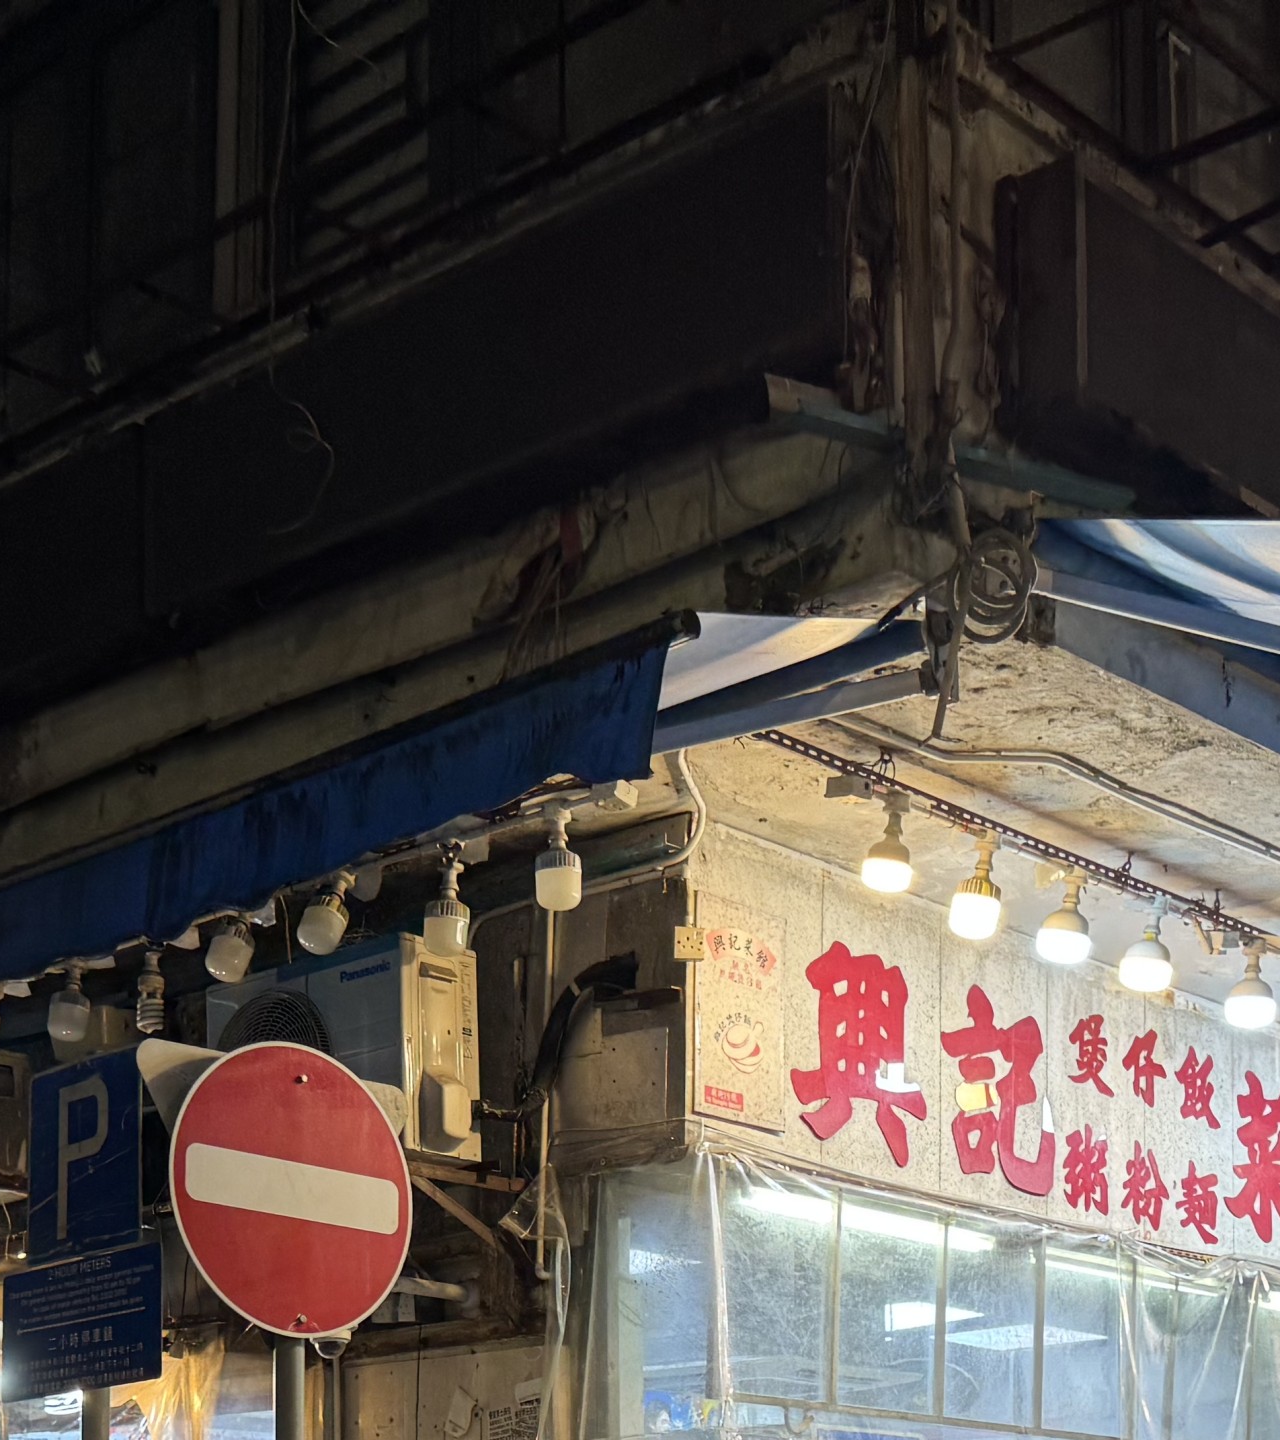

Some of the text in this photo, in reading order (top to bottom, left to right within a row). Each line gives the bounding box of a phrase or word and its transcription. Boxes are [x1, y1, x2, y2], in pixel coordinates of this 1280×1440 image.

[339, 959, 391, 983] Panasonic
[1068, 1014, 1221, 1129] 煲仔飯
[57, 1072, 109, 1241] P
[1063, 1124, 1219, 1245] 粥粉麵
[79, 1256, 112, 1273] METERS
